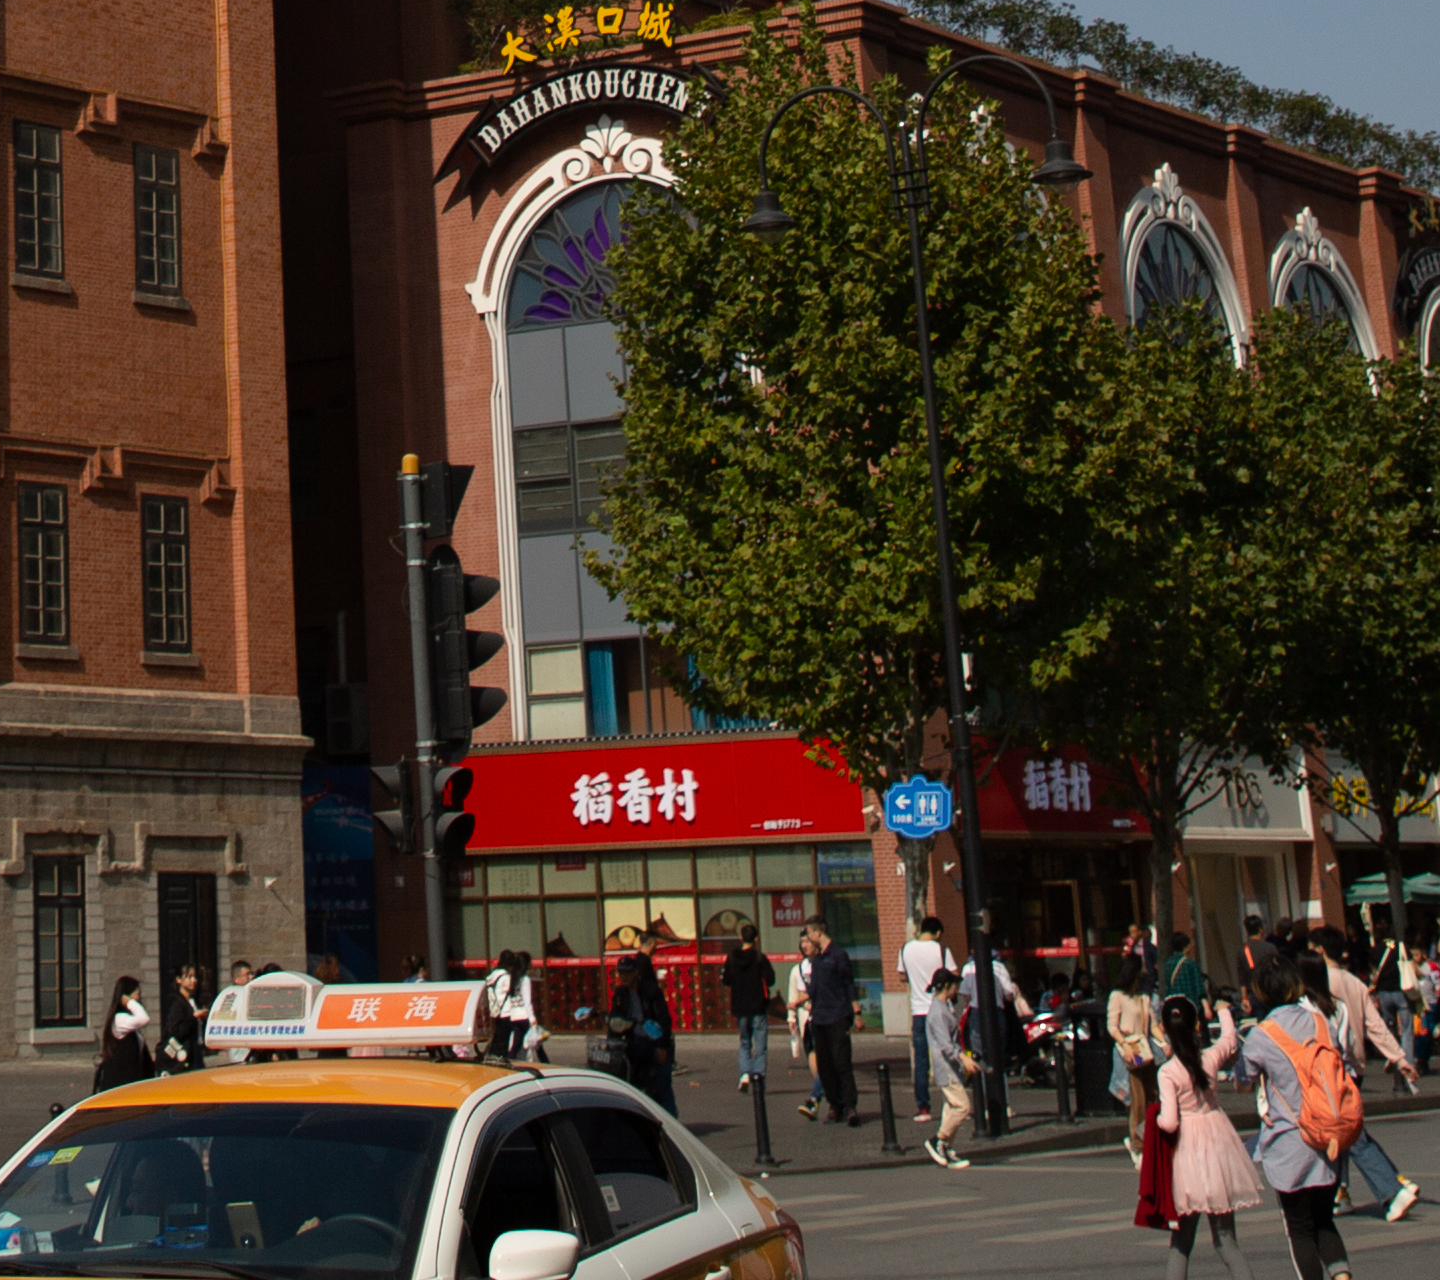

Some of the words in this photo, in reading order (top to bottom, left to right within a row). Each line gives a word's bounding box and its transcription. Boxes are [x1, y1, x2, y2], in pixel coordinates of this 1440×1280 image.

[570, 767, 700, 826] 稻香村
[1023, 758, 1092, 812] 稻香村
